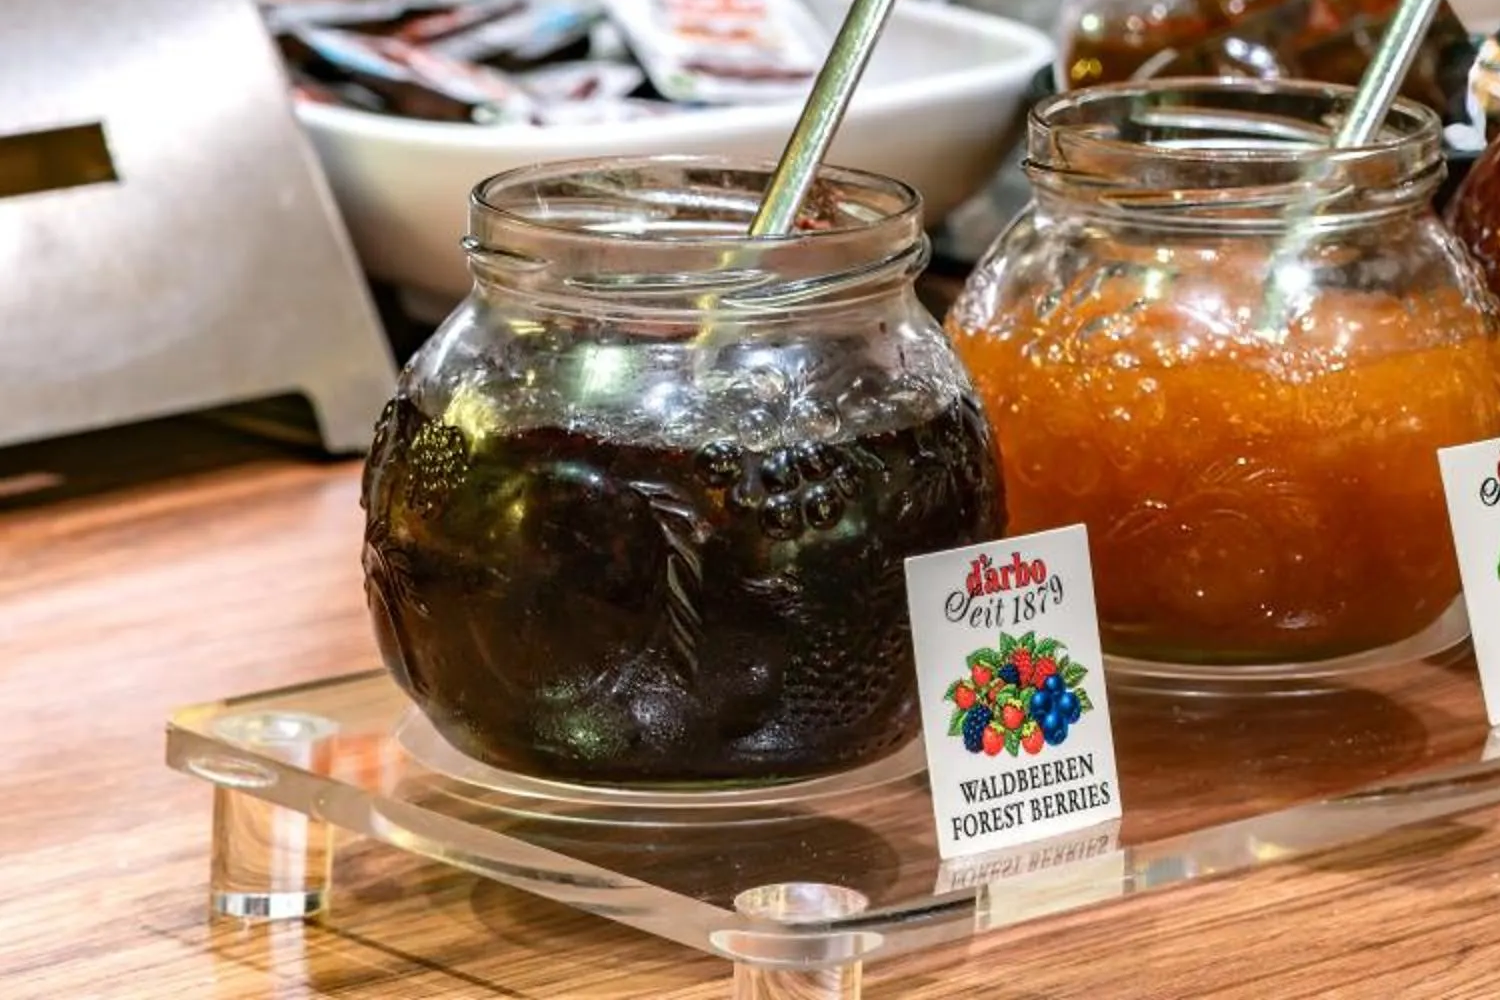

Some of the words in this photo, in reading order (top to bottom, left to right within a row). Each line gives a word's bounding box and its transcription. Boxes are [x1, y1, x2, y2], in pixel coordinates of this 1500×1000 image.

[944, 588, 1004, 628] Seit
[1013, 575, 1064, 625] 1879
[960, 753, 1095, 805] WALDBEEREN
[952, 801, 1024, 841] FOREST
[1032, 782, 1111, 823] BERRIES
